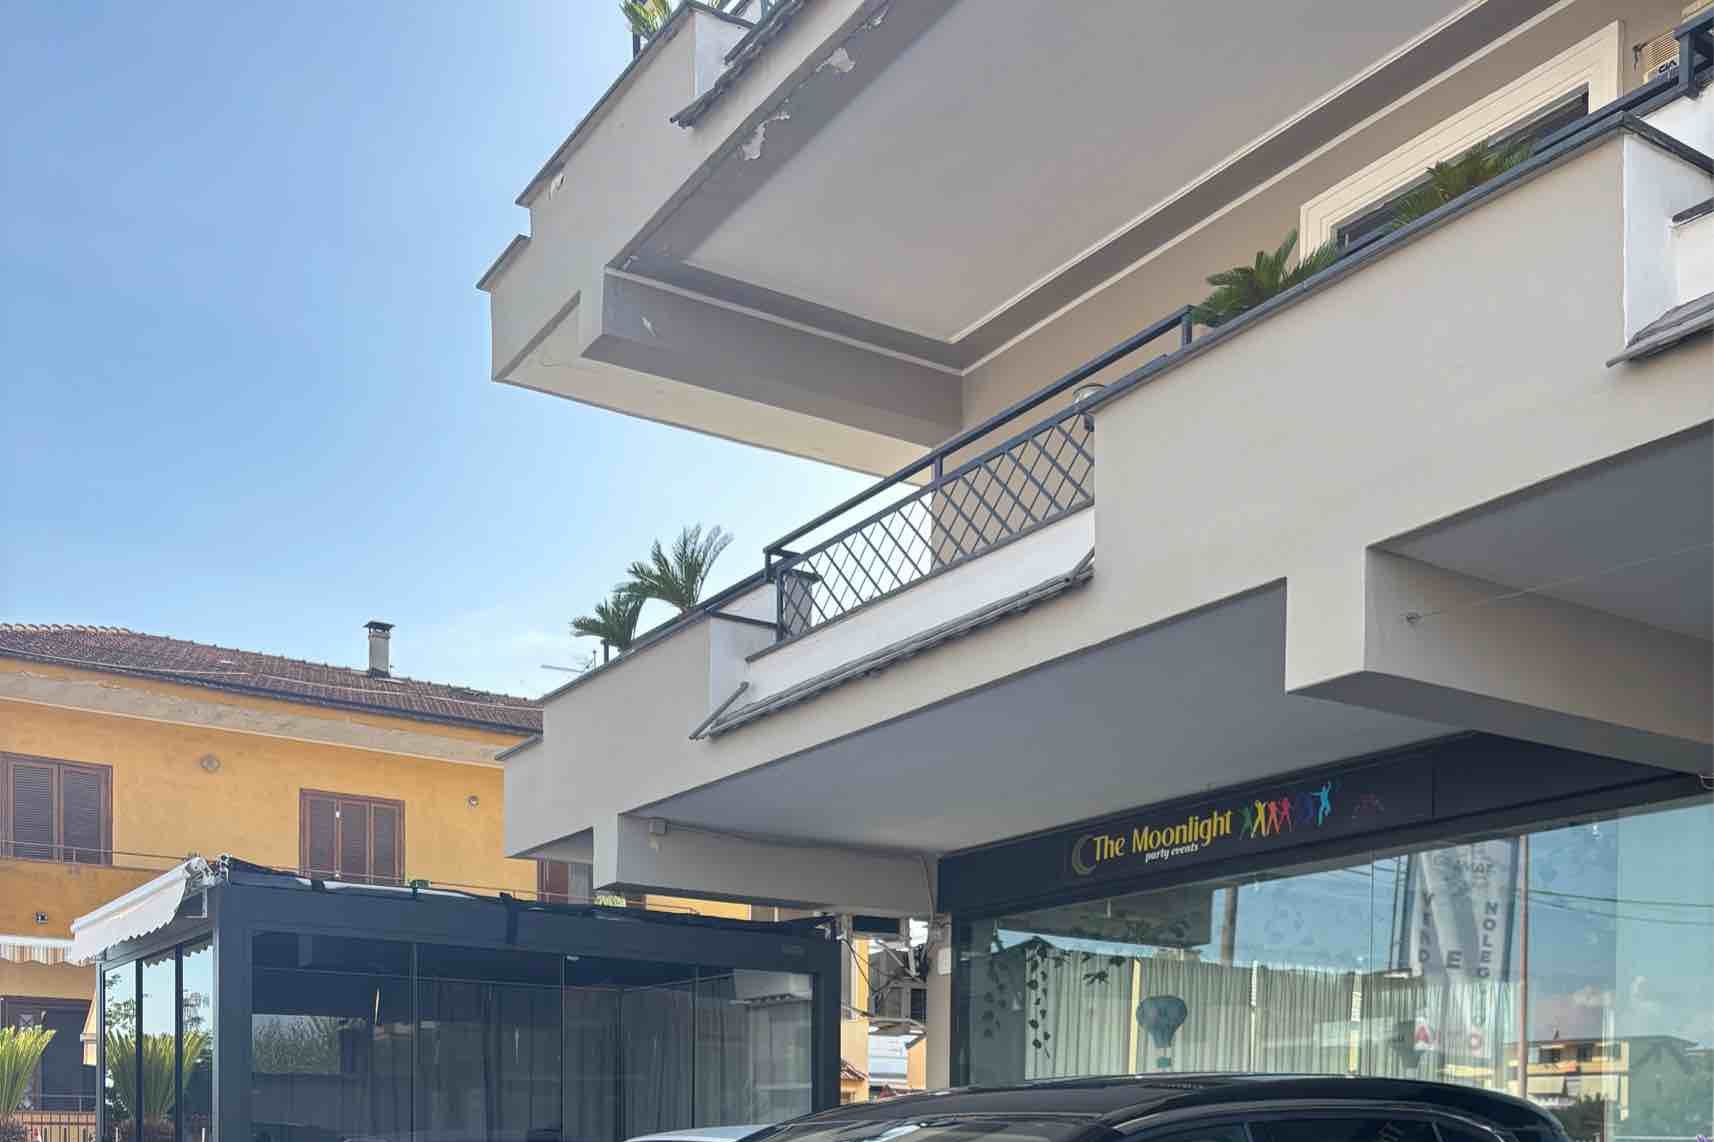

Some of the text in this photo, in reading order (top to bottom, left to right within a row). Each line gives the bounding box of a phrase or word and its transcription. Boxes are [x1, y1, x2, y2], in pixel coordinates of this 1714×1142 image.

[1093, 810, 1232, 861] The Moonlight
[1145, 843, 1200, 863] party events
